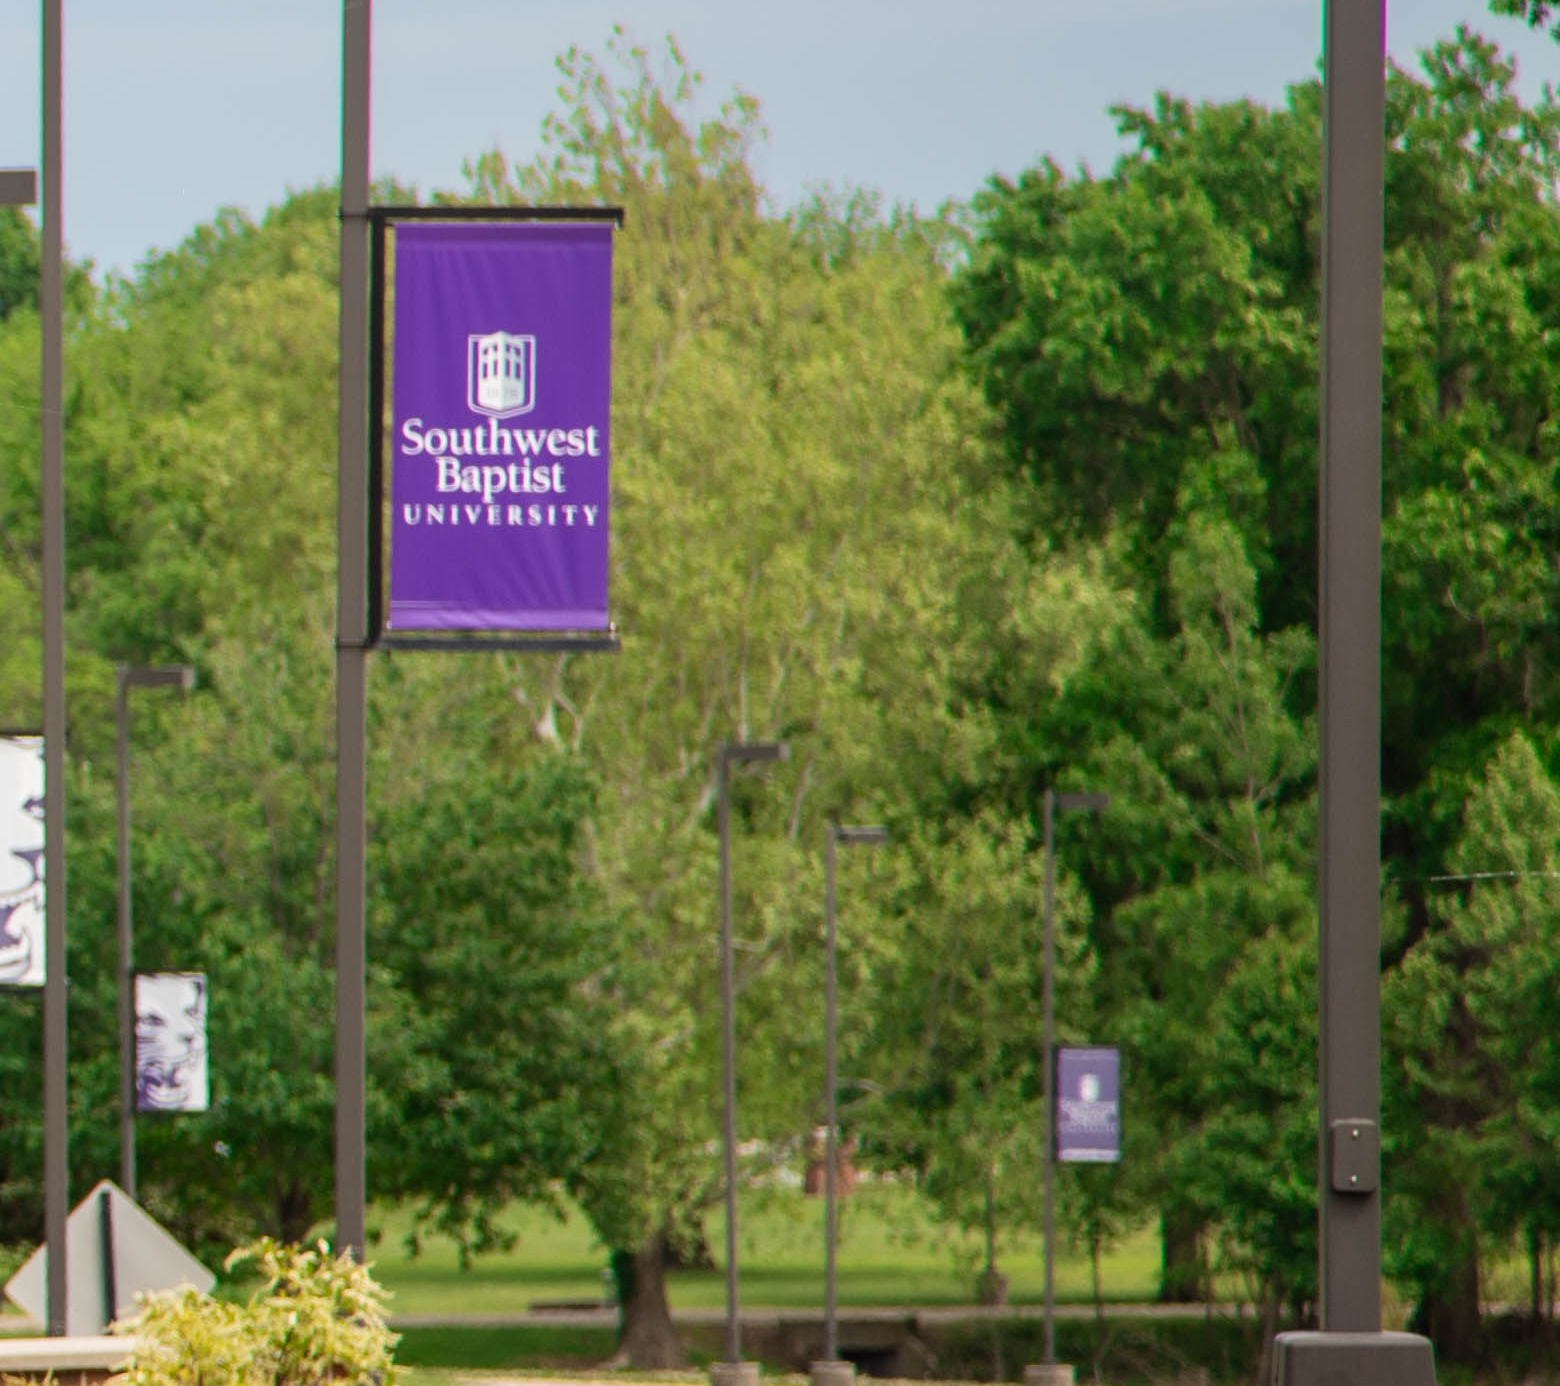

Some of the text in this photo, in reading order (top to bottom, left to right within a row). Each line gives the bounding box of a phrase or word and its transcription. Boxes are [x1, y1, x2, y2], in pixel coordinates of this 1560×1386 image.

[401, 417, 600, 456] Southwest
[436, 456, 566, 503] Baptist
[403, 504, 598, 526] UNIVERSITY
